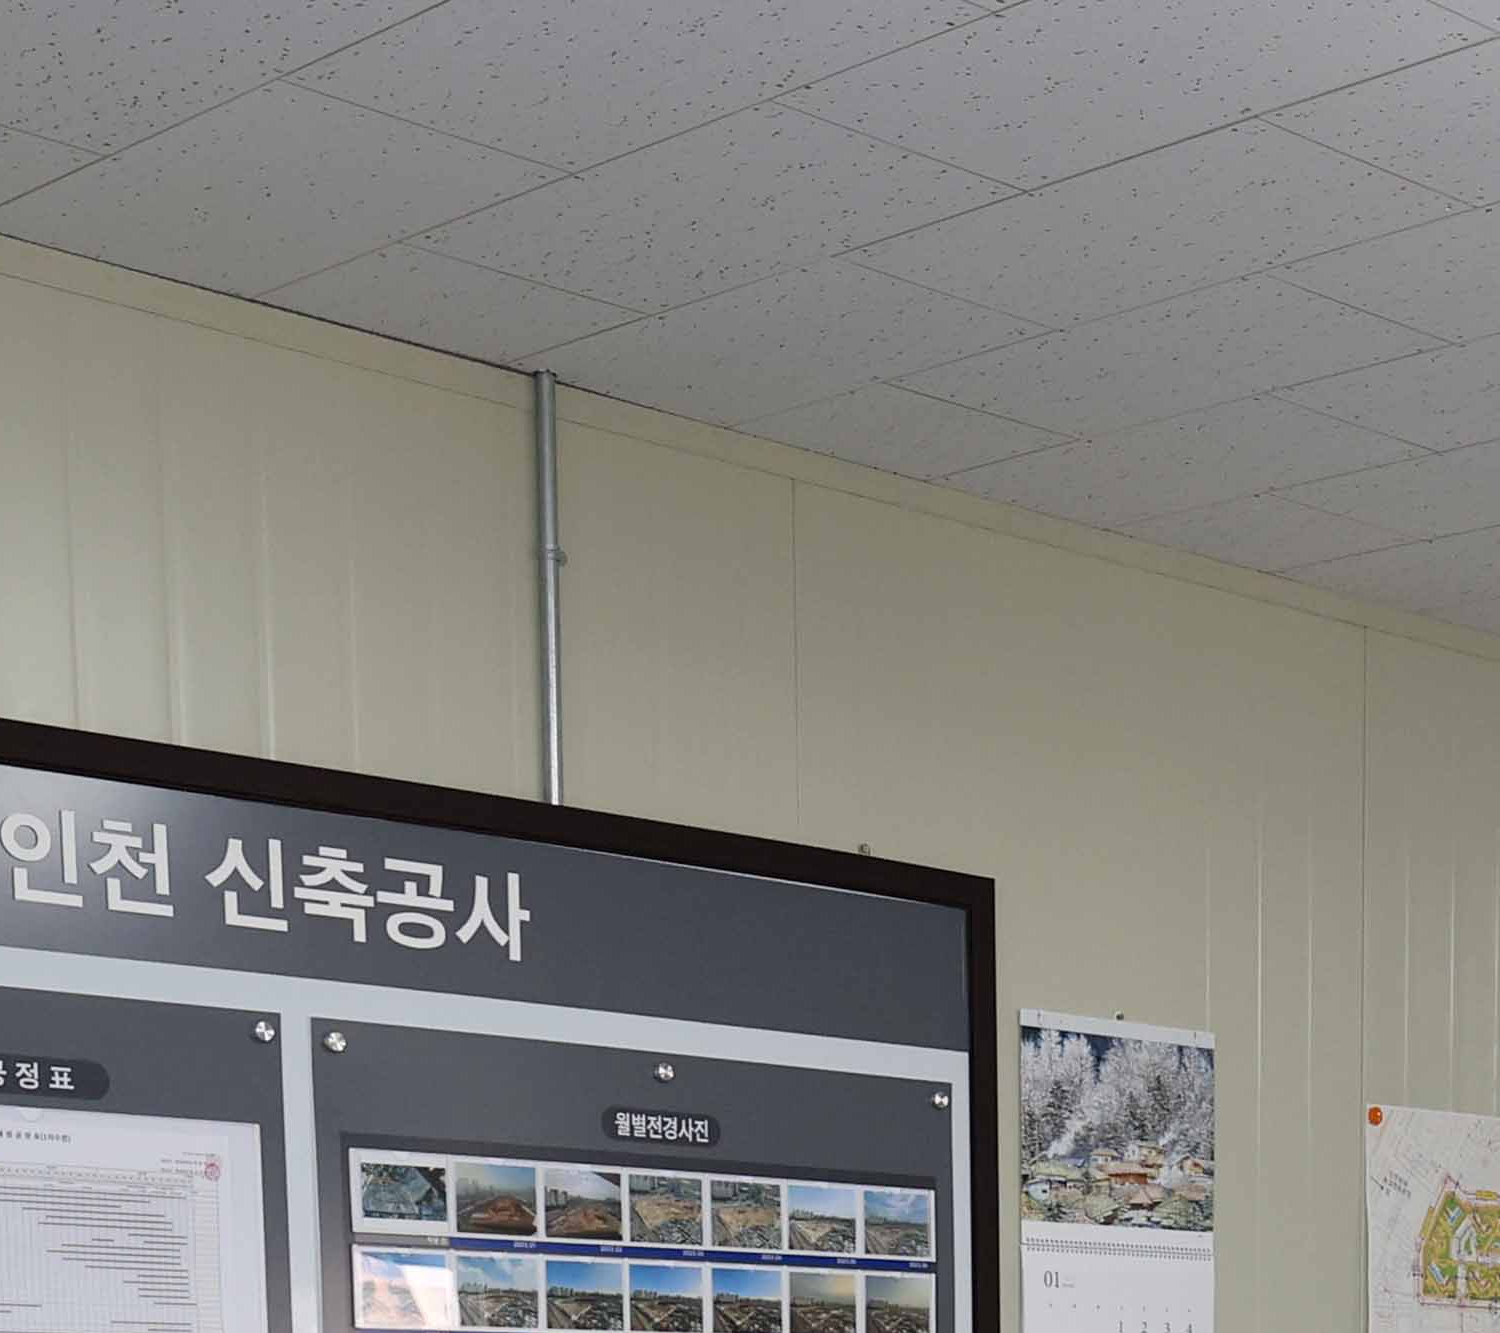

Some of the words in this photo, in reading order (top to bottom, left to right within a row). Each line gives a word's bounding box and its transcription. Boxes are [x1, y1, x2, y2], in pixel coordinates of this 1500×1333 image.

[205, 835, 532, 964] 신축공사
[614, 1112, 709, 1143] 월별전경사진
[1044, 1271, 1059, 1288] 01
[1118, 1321, 1123, 1333] 1
[1141, 1322, 1148, 1333] 2
